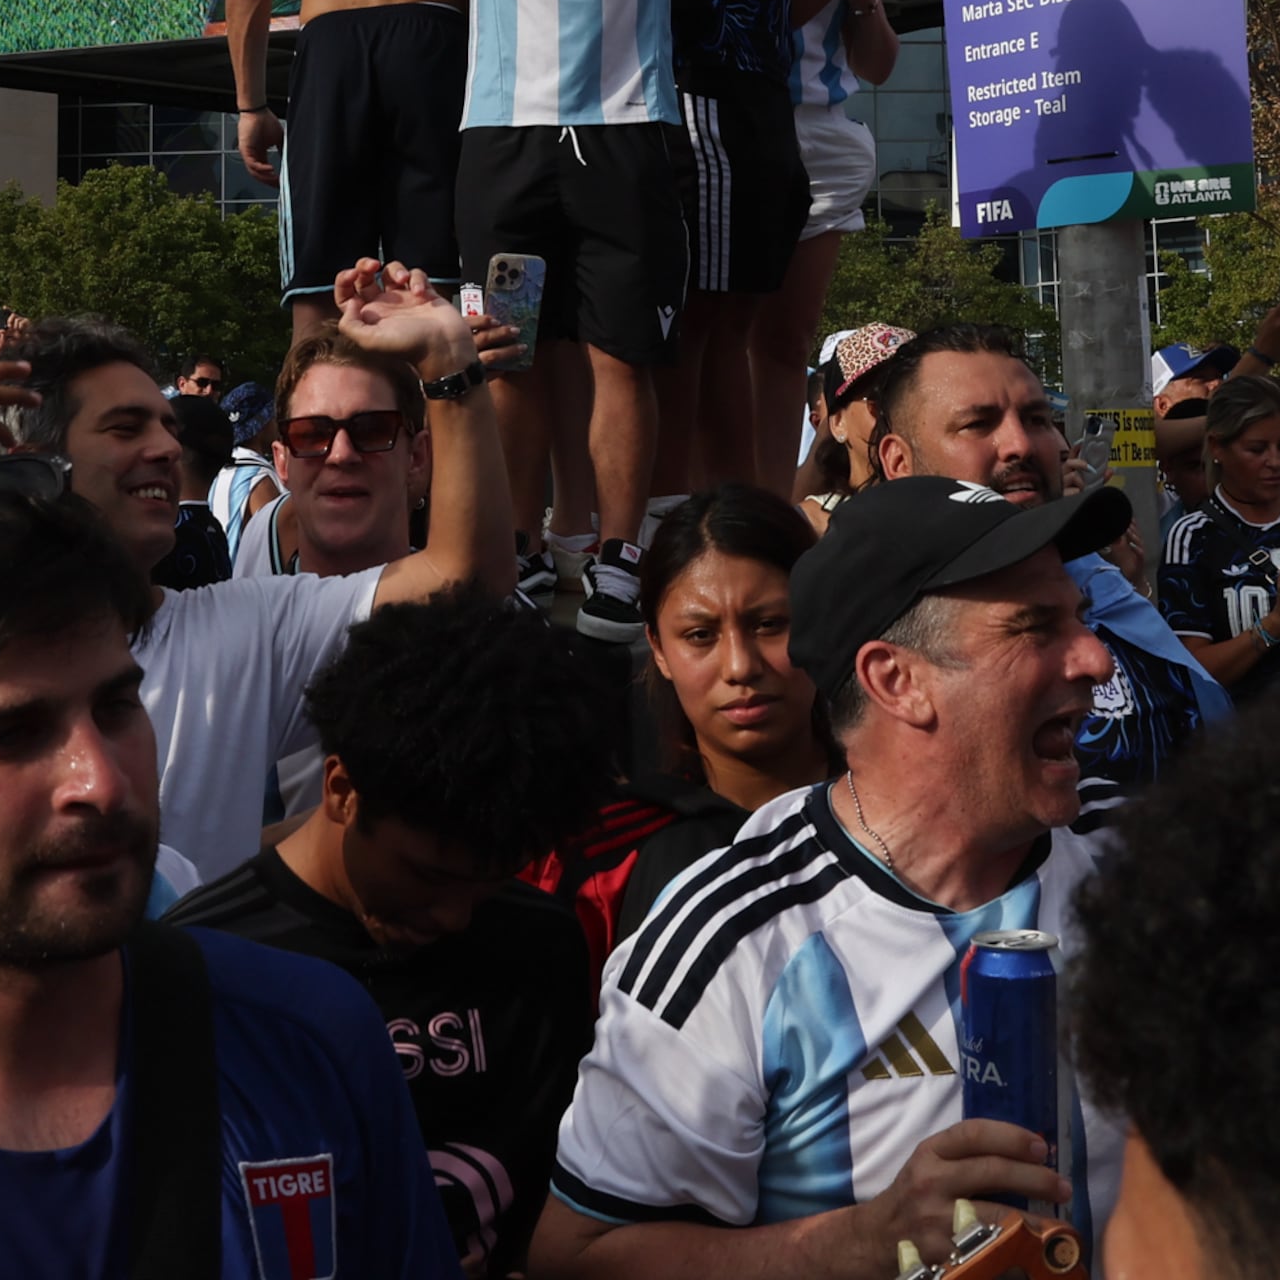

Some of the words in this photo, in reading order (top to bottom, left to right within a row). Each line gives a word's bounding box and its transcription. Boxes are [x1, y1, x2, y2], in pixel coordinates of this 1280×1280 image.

[962, 1, 1003, 23] Marta
[964, 36, 1025, 63] Entrance
[1030, 32, 1039, 50] E
[967, 73, 1037, 103] Restricted
[1040, 70, 1081, 89] Item
[969, 106, 1021, 128] Storage
[1034, 94, 1067, 116] Teal
[976, 199, 1014, 224] FIFA
[1171, 190, 1232, 205] ATLANTA
[1223, 585, 1271, 638] 10
[386, 1008, 486, 1080] SSI
[253, 1170, 325, 1200] TIGRE
